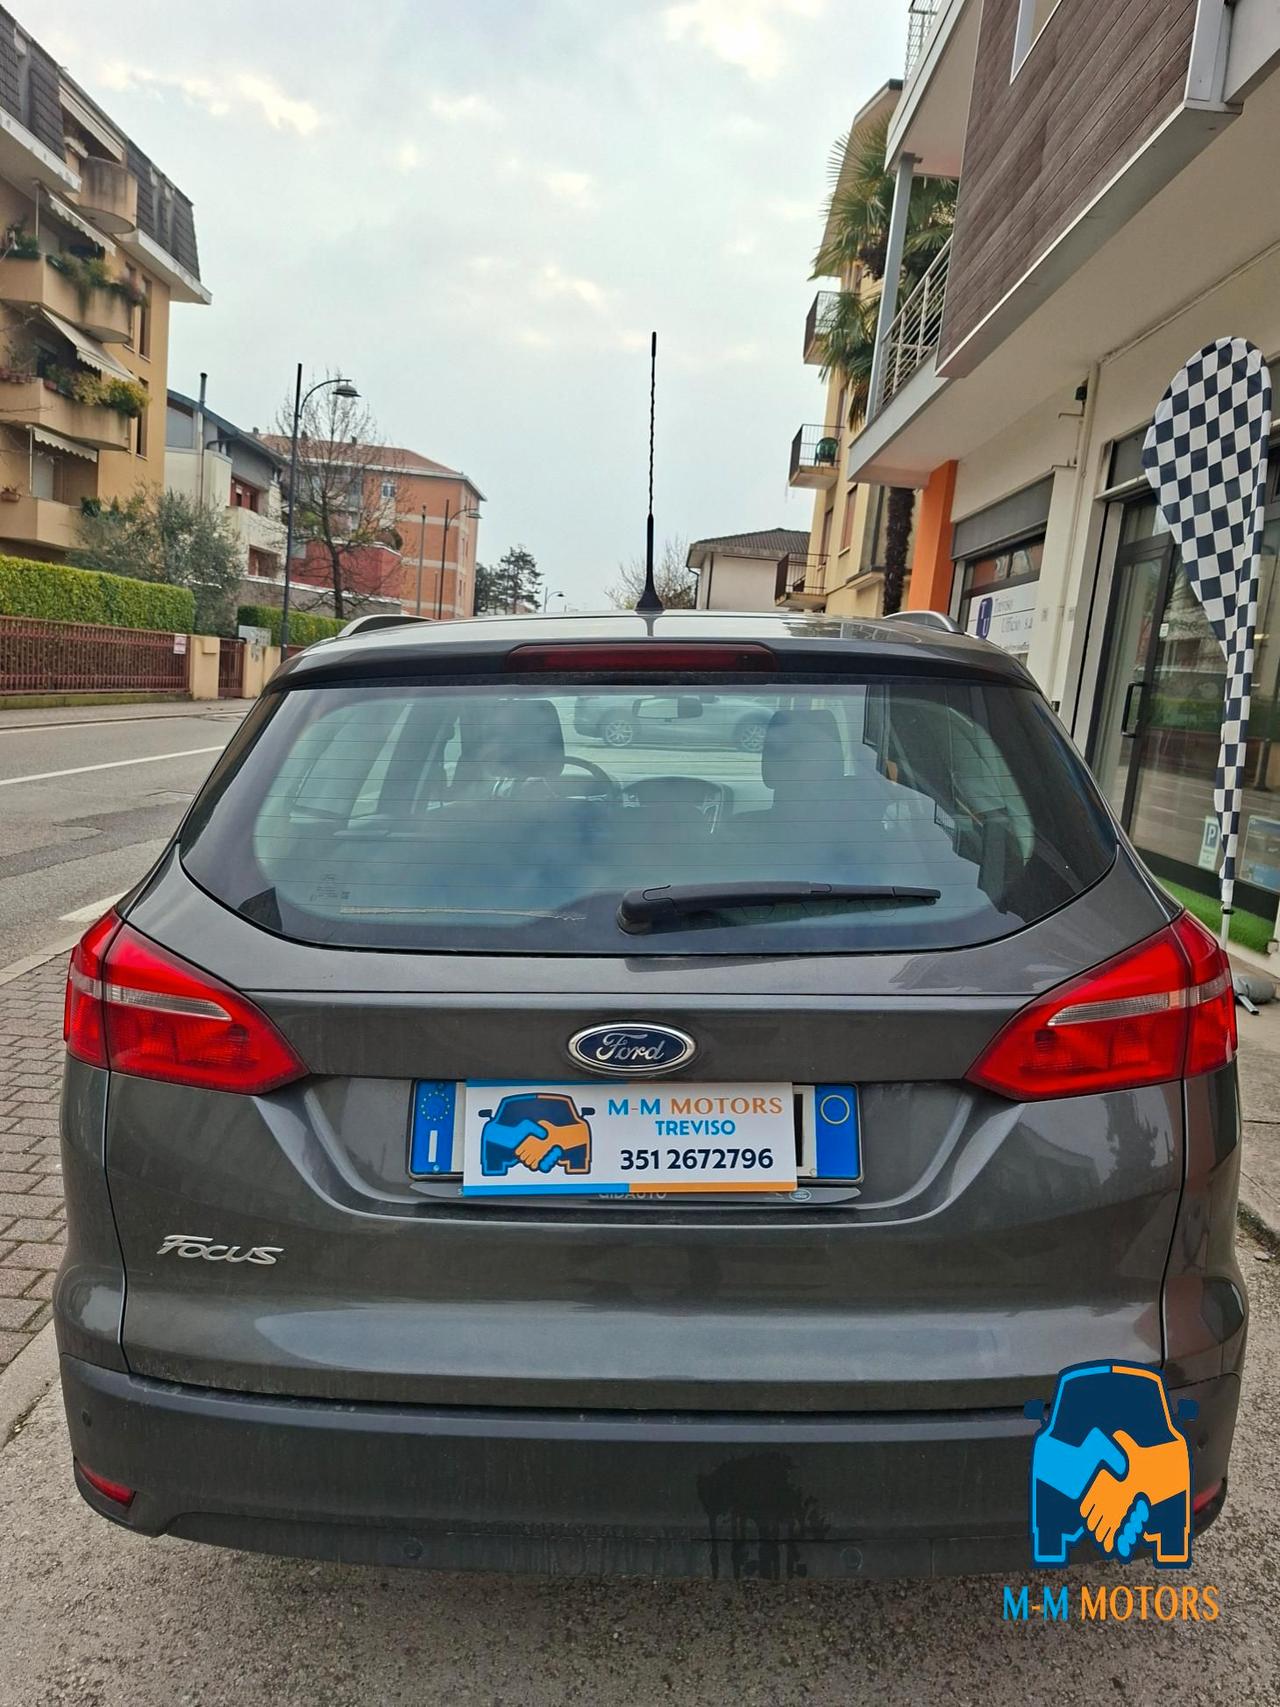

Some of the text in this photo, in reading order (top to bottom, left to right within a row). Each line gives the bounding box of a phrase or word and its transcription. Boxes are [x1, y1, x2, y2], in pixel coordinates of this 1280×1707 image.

[1207, 825, 1217, 845] P
[596, 1033, 664, 1060] Ford
[608, 1097, 783, 1115] M-M MOTORS
[655, 1120, 736, 1136] TREVISO
[620, 1148, 774, 1170] 351 2672796
